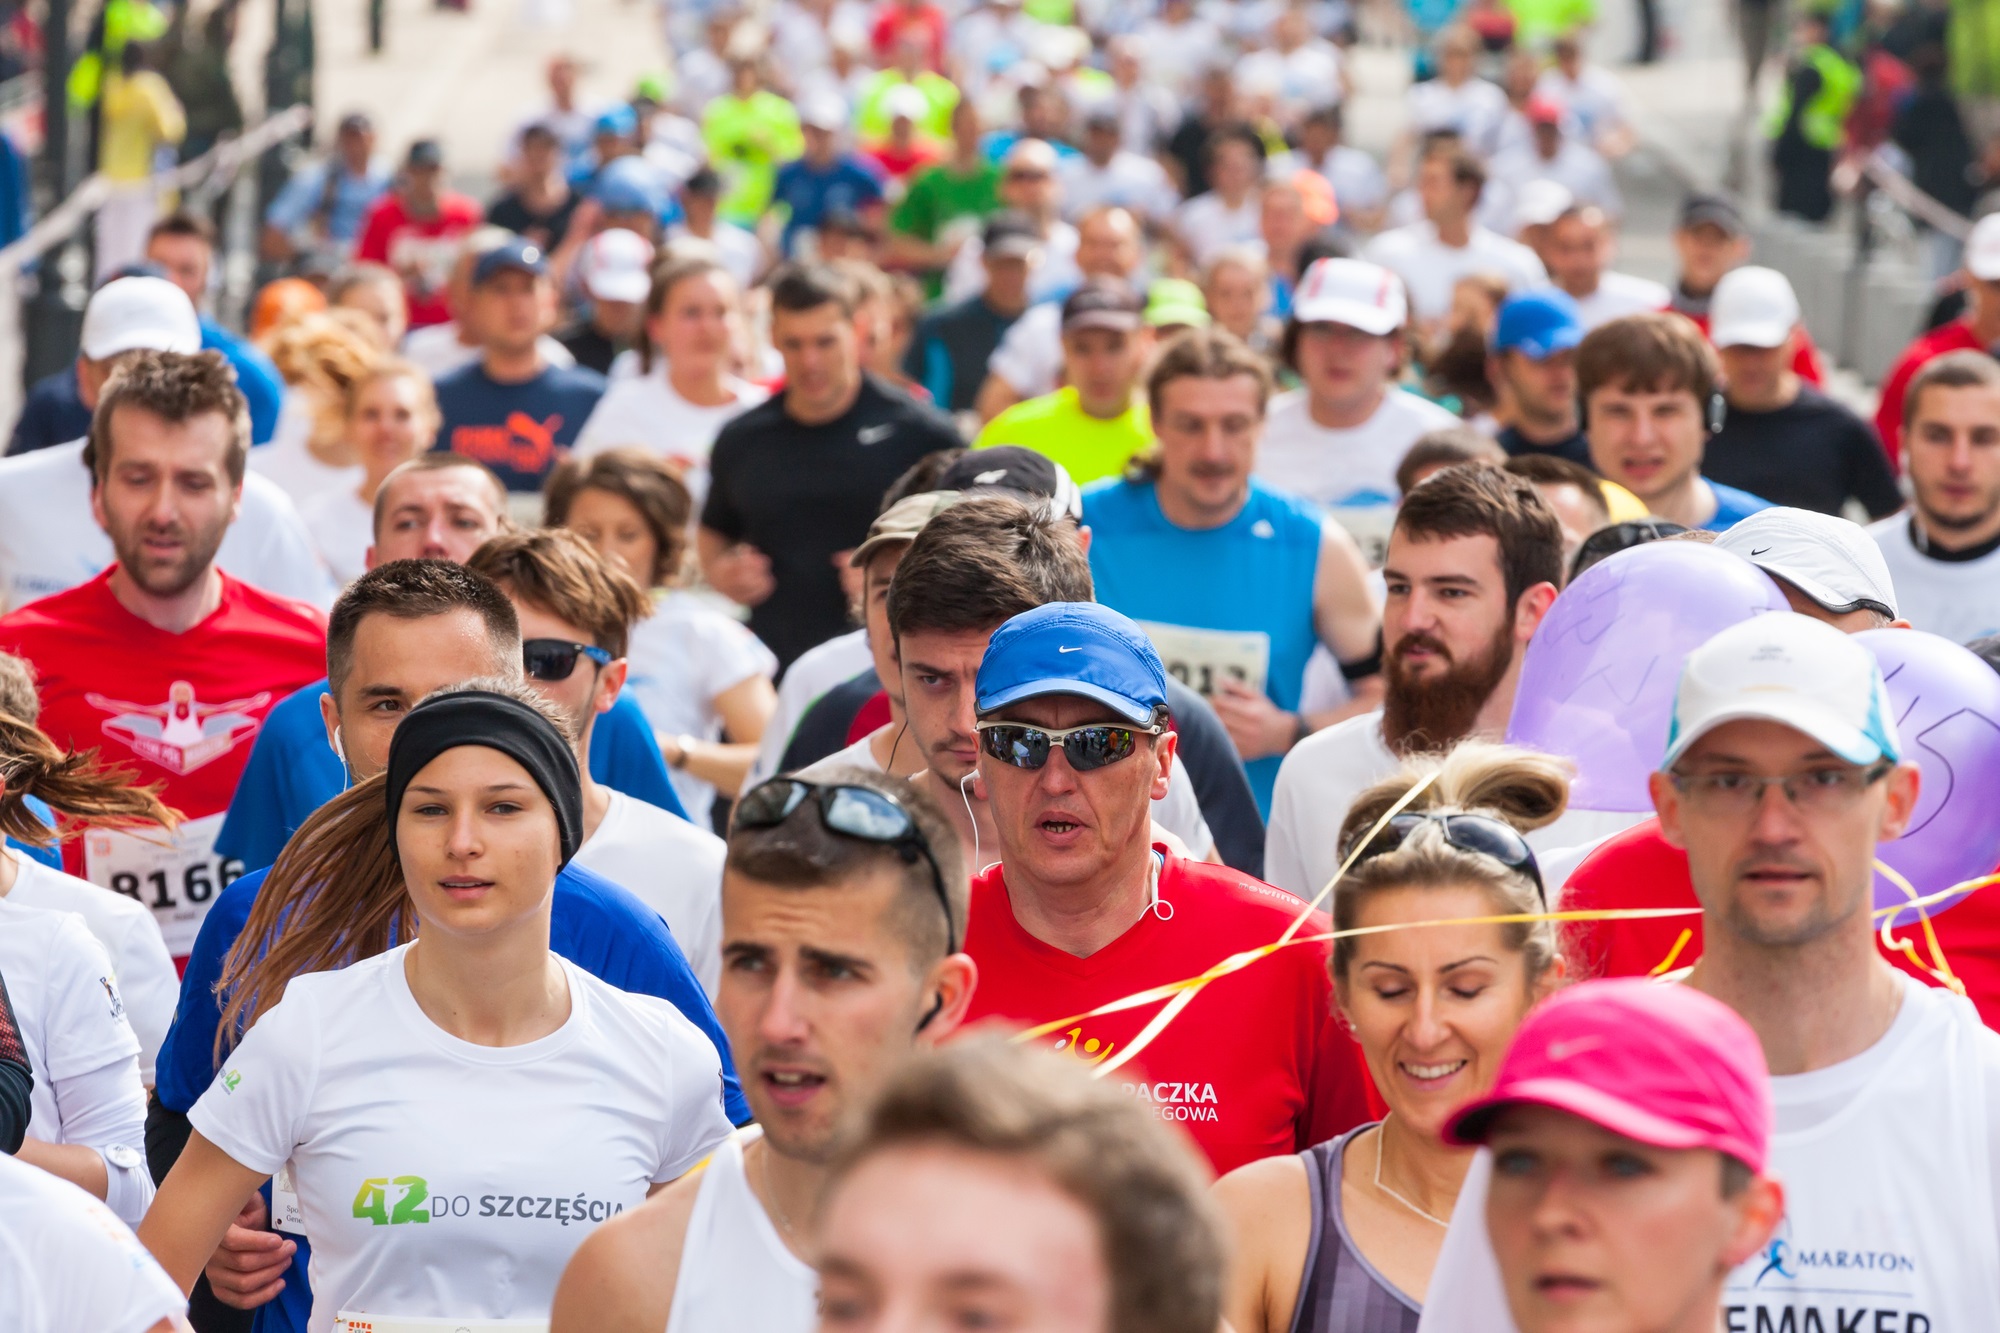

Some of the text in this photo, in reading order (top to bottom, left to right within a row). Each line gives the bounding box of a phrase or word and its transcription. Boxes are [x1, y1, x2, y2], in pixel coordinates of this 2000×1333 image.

[1122, 1082, 1218, 1104] PACZKA
[1152, 1106, 1219, 1122] EGOWA
[286, 1204, 299, 1214] Spo
[352, 1175, 430, 1225] 42
[431, 1195, 470, 1218] DO
[286, 1214, 303, 1224] Gene
[1797, 1250, 1915, 1272] MARATON
[1726, 1304, 1931, 1333] EMAKE
